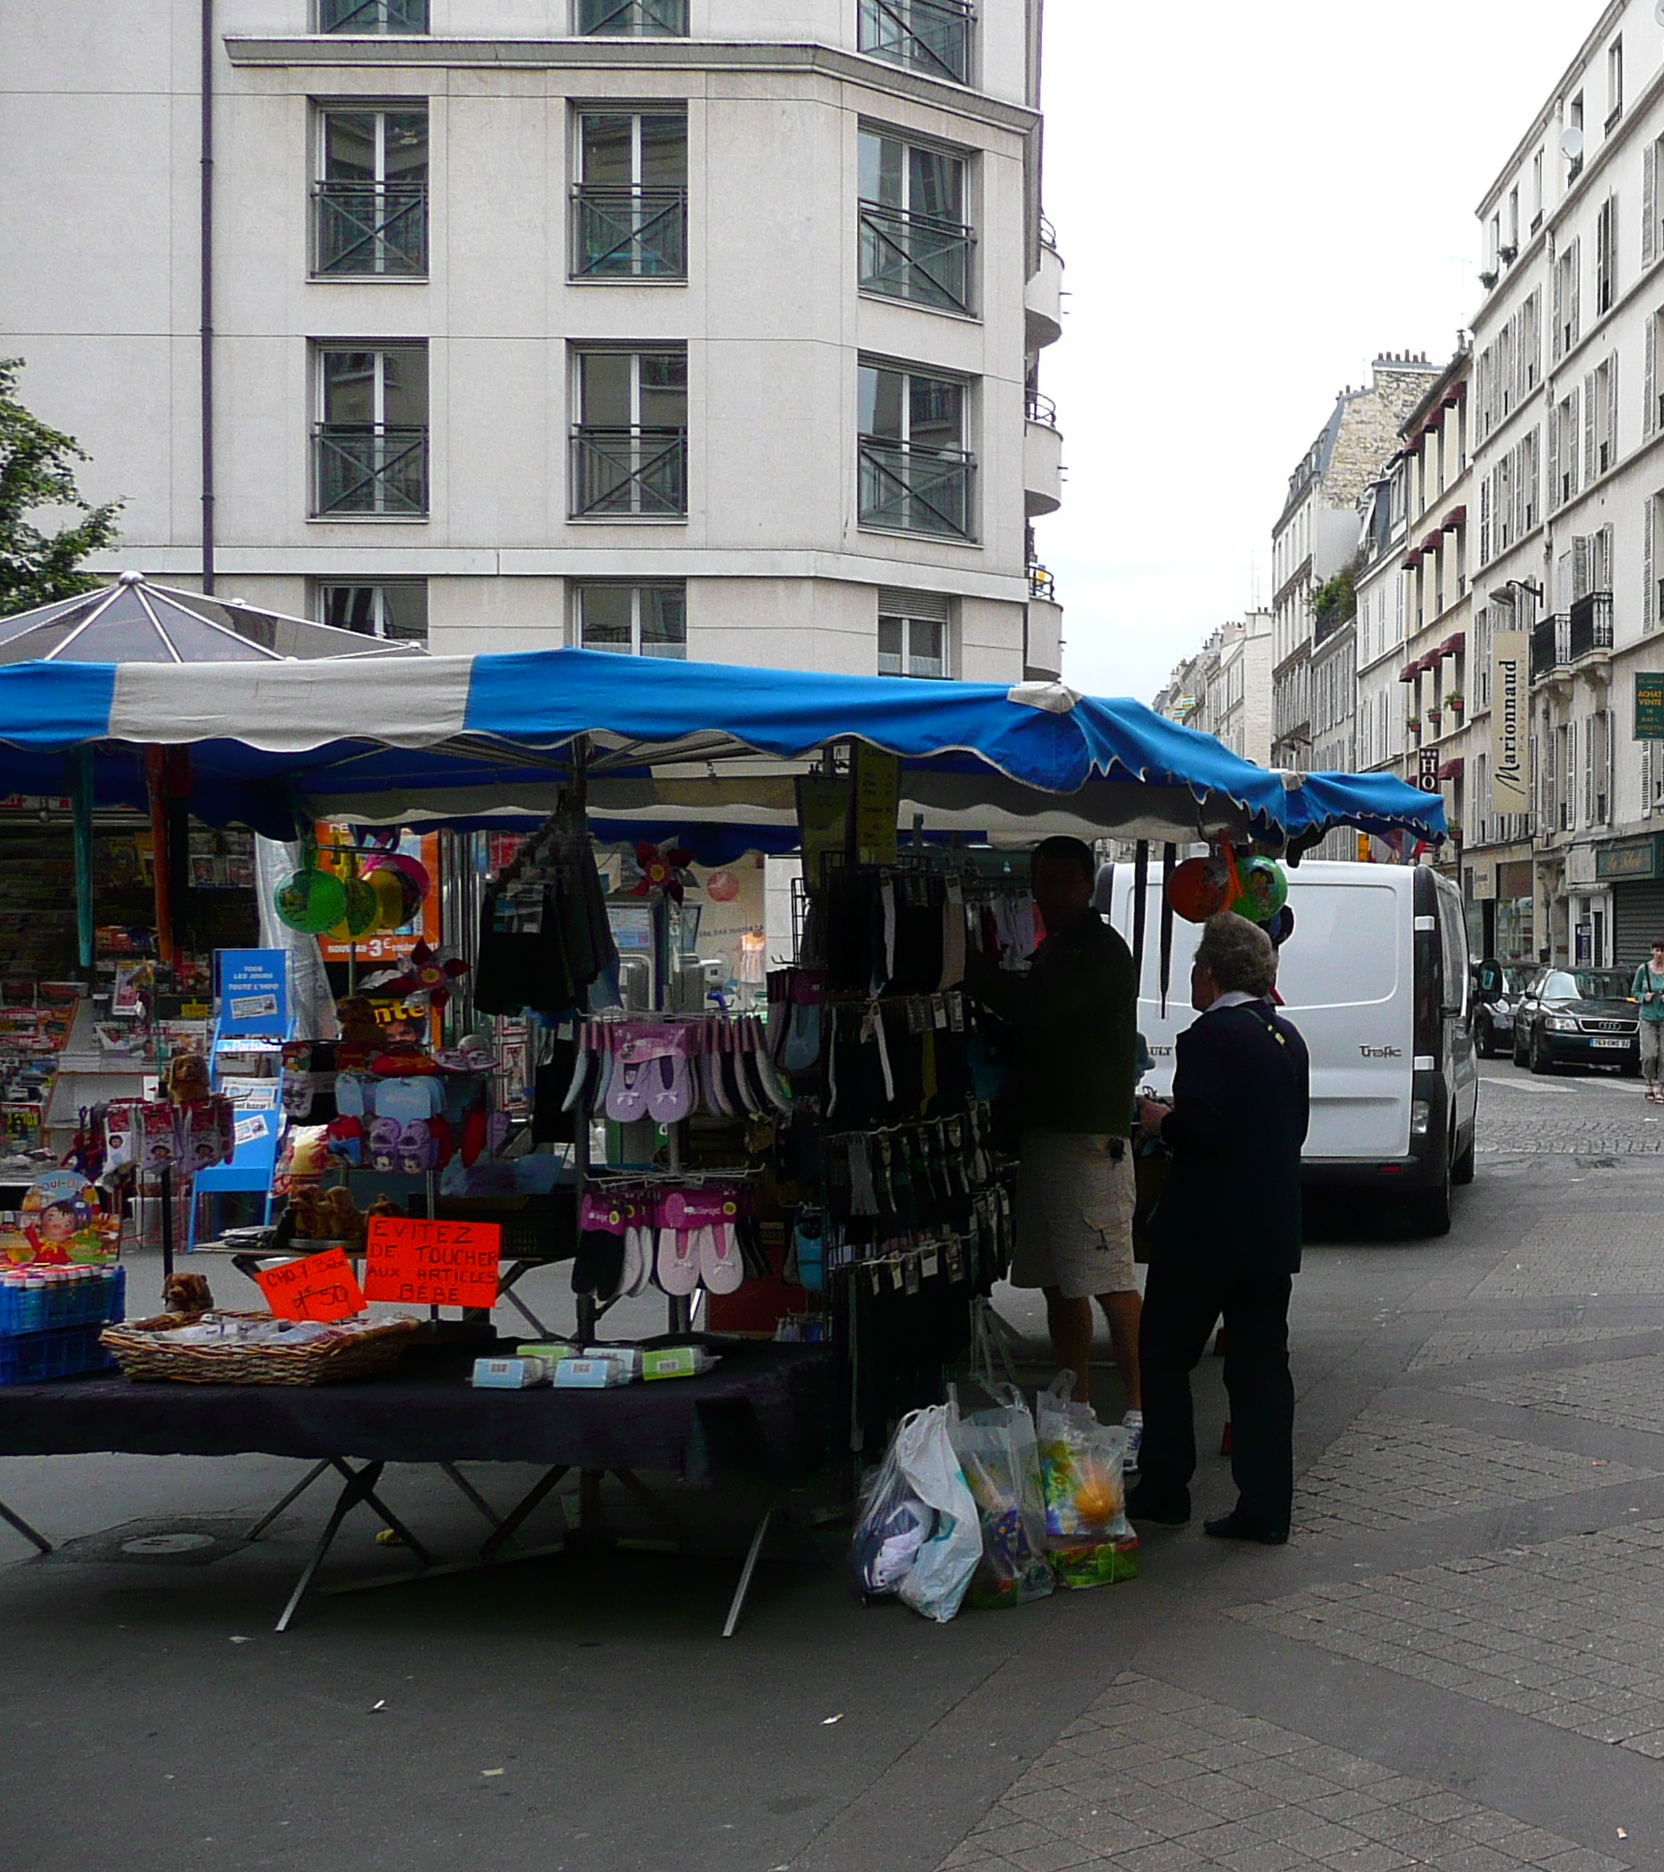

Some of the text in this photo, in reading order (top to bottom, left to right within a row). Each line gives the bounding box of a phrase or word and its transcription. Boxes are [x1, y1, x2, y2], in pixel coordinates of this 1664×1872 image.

[1494, 659, 1526, 795] Marionnaud
[1421, 758, 1436, 791] HO
[228, 983, 252, 991] TOUTE
[374, 1002, 426, 1024] nte
[1149, 1046, 1173, 1056] ULT
[1358, 1043, 1402, 1058] Trafic
[373, 1220, 474, 1245] EVITEZ
[368, 1242, 499, 1266] DE TOUCHER
[367, 1264, 498, 1284] AUX ARTICLES
